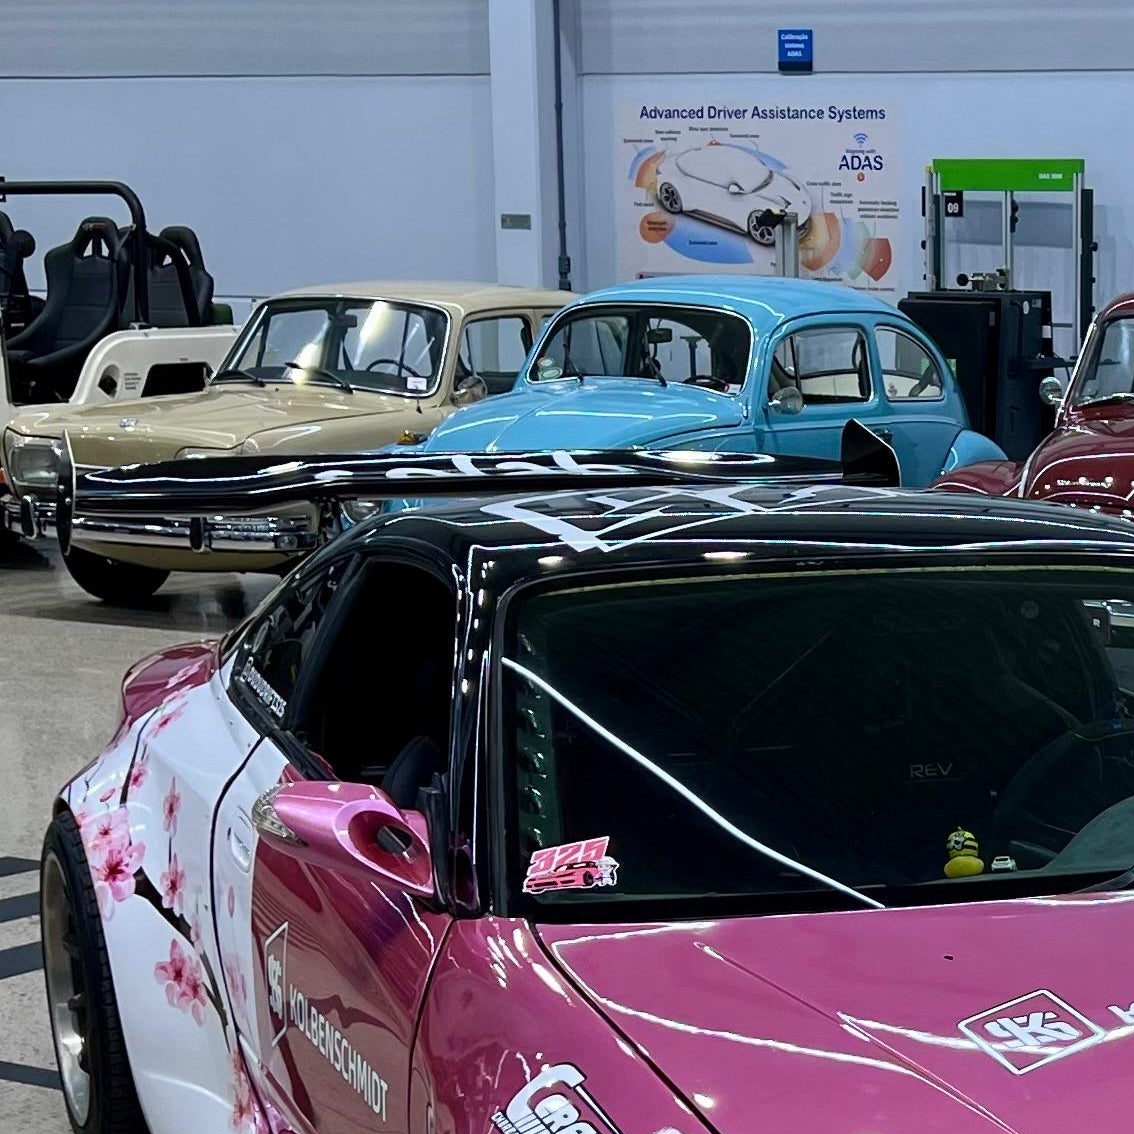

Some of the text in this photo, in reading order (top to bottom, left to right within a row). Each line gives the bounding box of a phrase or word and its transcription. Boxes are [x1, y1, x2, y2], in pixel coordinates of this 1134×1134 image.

[640, 105, 886, 123] Advanced Driver Assistance Systems
[838, 154, 884, 171] ADAS
[947, 202, 959, 213] 09
[910, 762, 953, 779] REV
[289, 983, 389, 1122] KOLBENSCHMIDT
